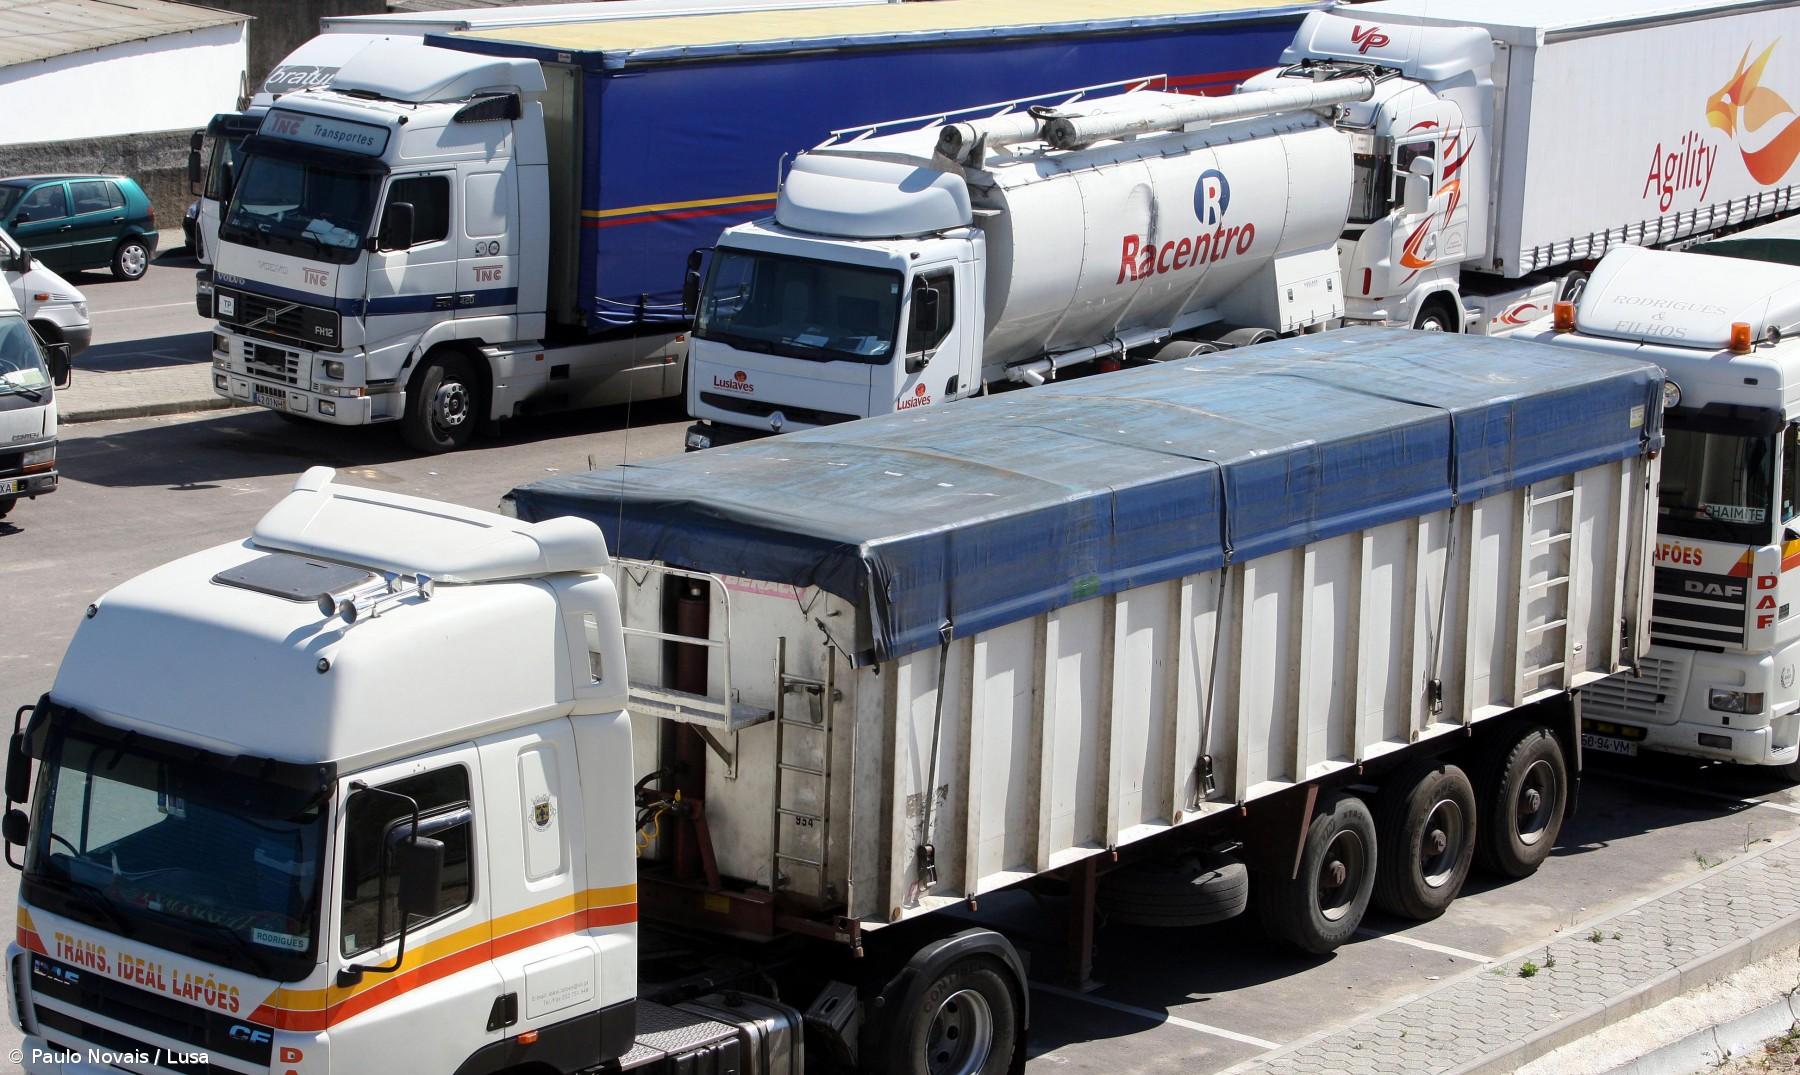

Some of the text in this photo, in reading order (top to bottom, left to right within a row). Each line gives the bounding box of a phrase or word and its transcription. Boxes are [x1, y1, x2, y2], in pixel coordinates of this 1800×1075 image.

[1351, 25, 1391, 54] VP
[269, 111, 375, 147] TNC Transportes
[1642, 130, 1717, 212] Agility
[1116, 222, 1256, 286] Racentro
[303, 267, 330, 287] TNC
[473, 265, 504, 282] TNC
[1613, 295, 1729, 316] RODRIGUES
[1615, 320, 1689, 339] FILHOS
[713, 375, 755, 393] Lusiaves
[896, 395, 932, 411] Lusiaves
[1655, 541, 1703, 567] AFÕES
[1684, 580, 1743, 597] DAF
[1755, 575, 1778, 630] DAF
[256, 931, 305, 949] RODRIGUES
[54, 932, 241, 1014] TRANS. IDEAL LAFÕES
[229, 1024, 272, 1044] CF
